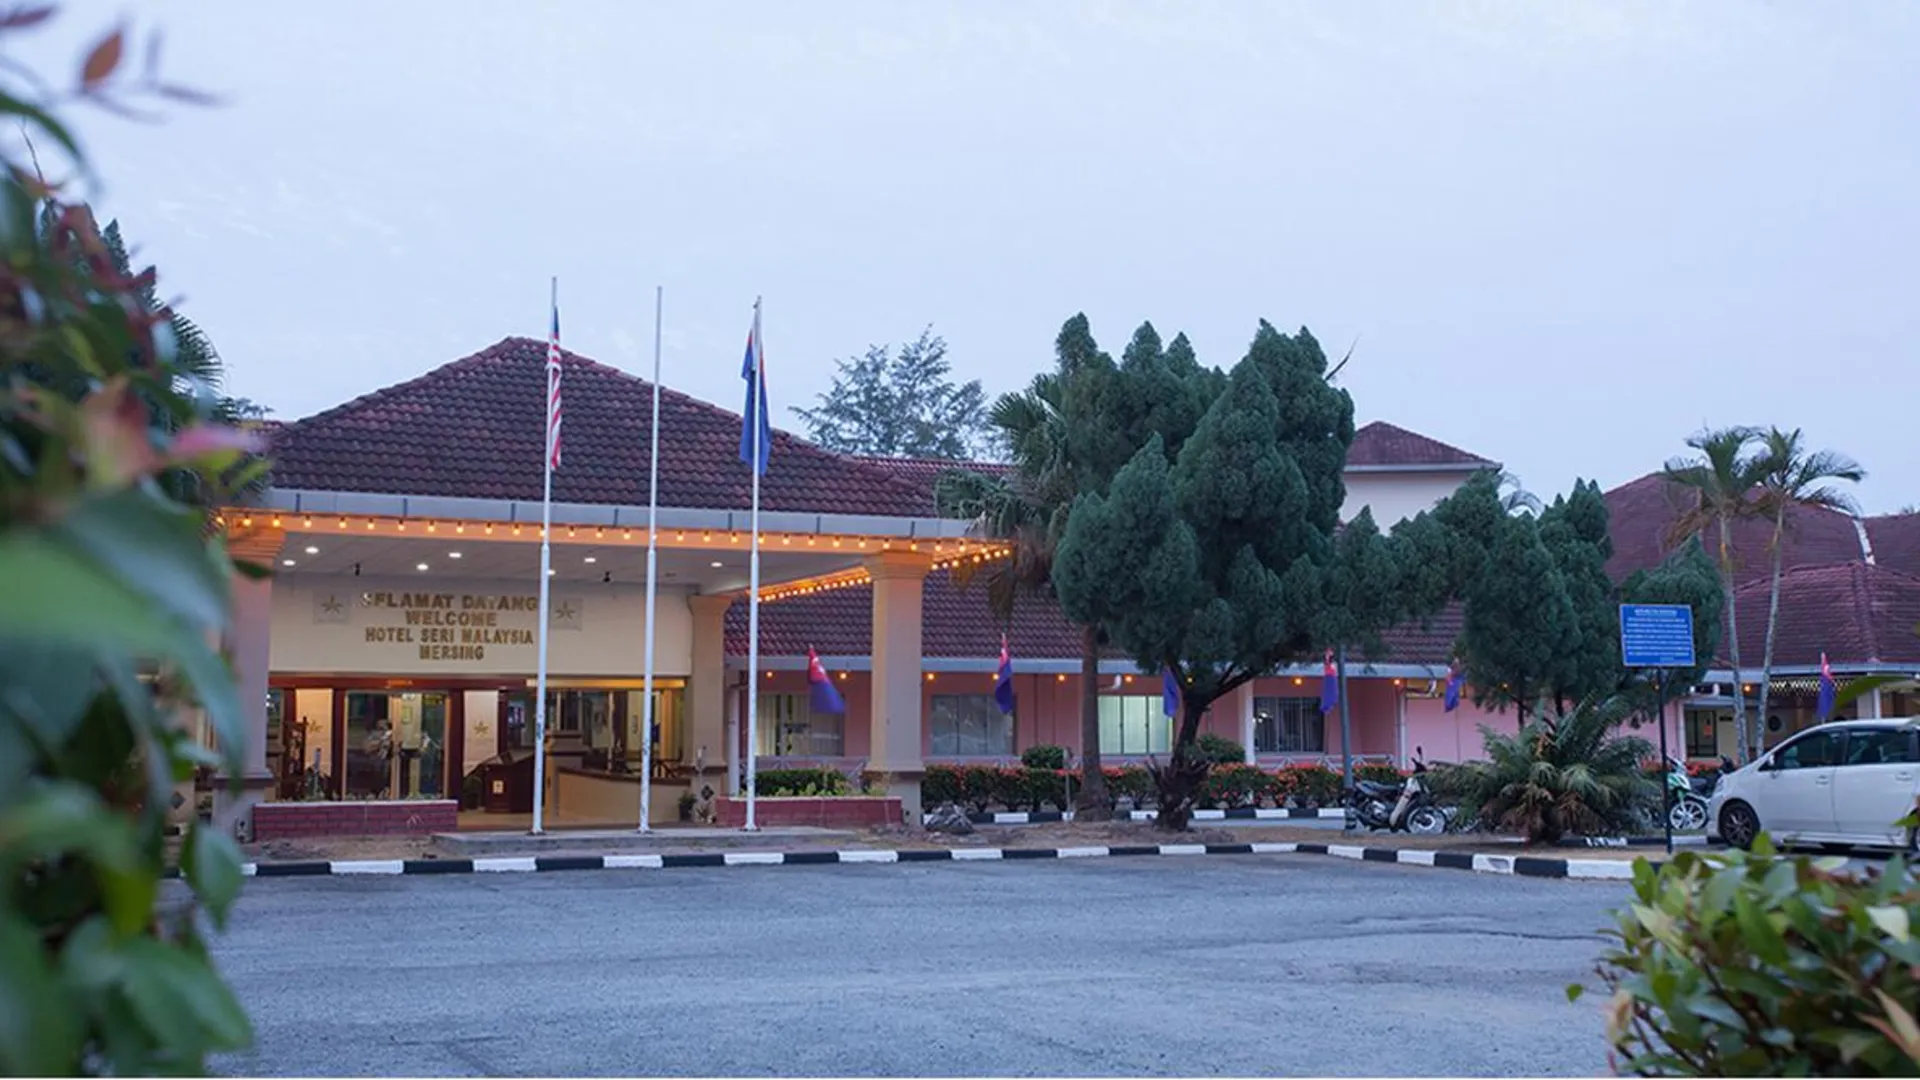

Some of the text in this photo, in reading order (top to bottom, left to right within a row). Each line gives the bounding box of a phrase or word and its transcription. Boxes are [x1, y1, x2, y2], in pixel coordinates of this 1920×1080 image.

[461, 595, 538, 611] DATANG
[405, 610, 497, 627] WELCOME
[365, 626, 533, 645] HOTEL SERI MALAYSIA
[419, 645, 484, 660] MERSING
